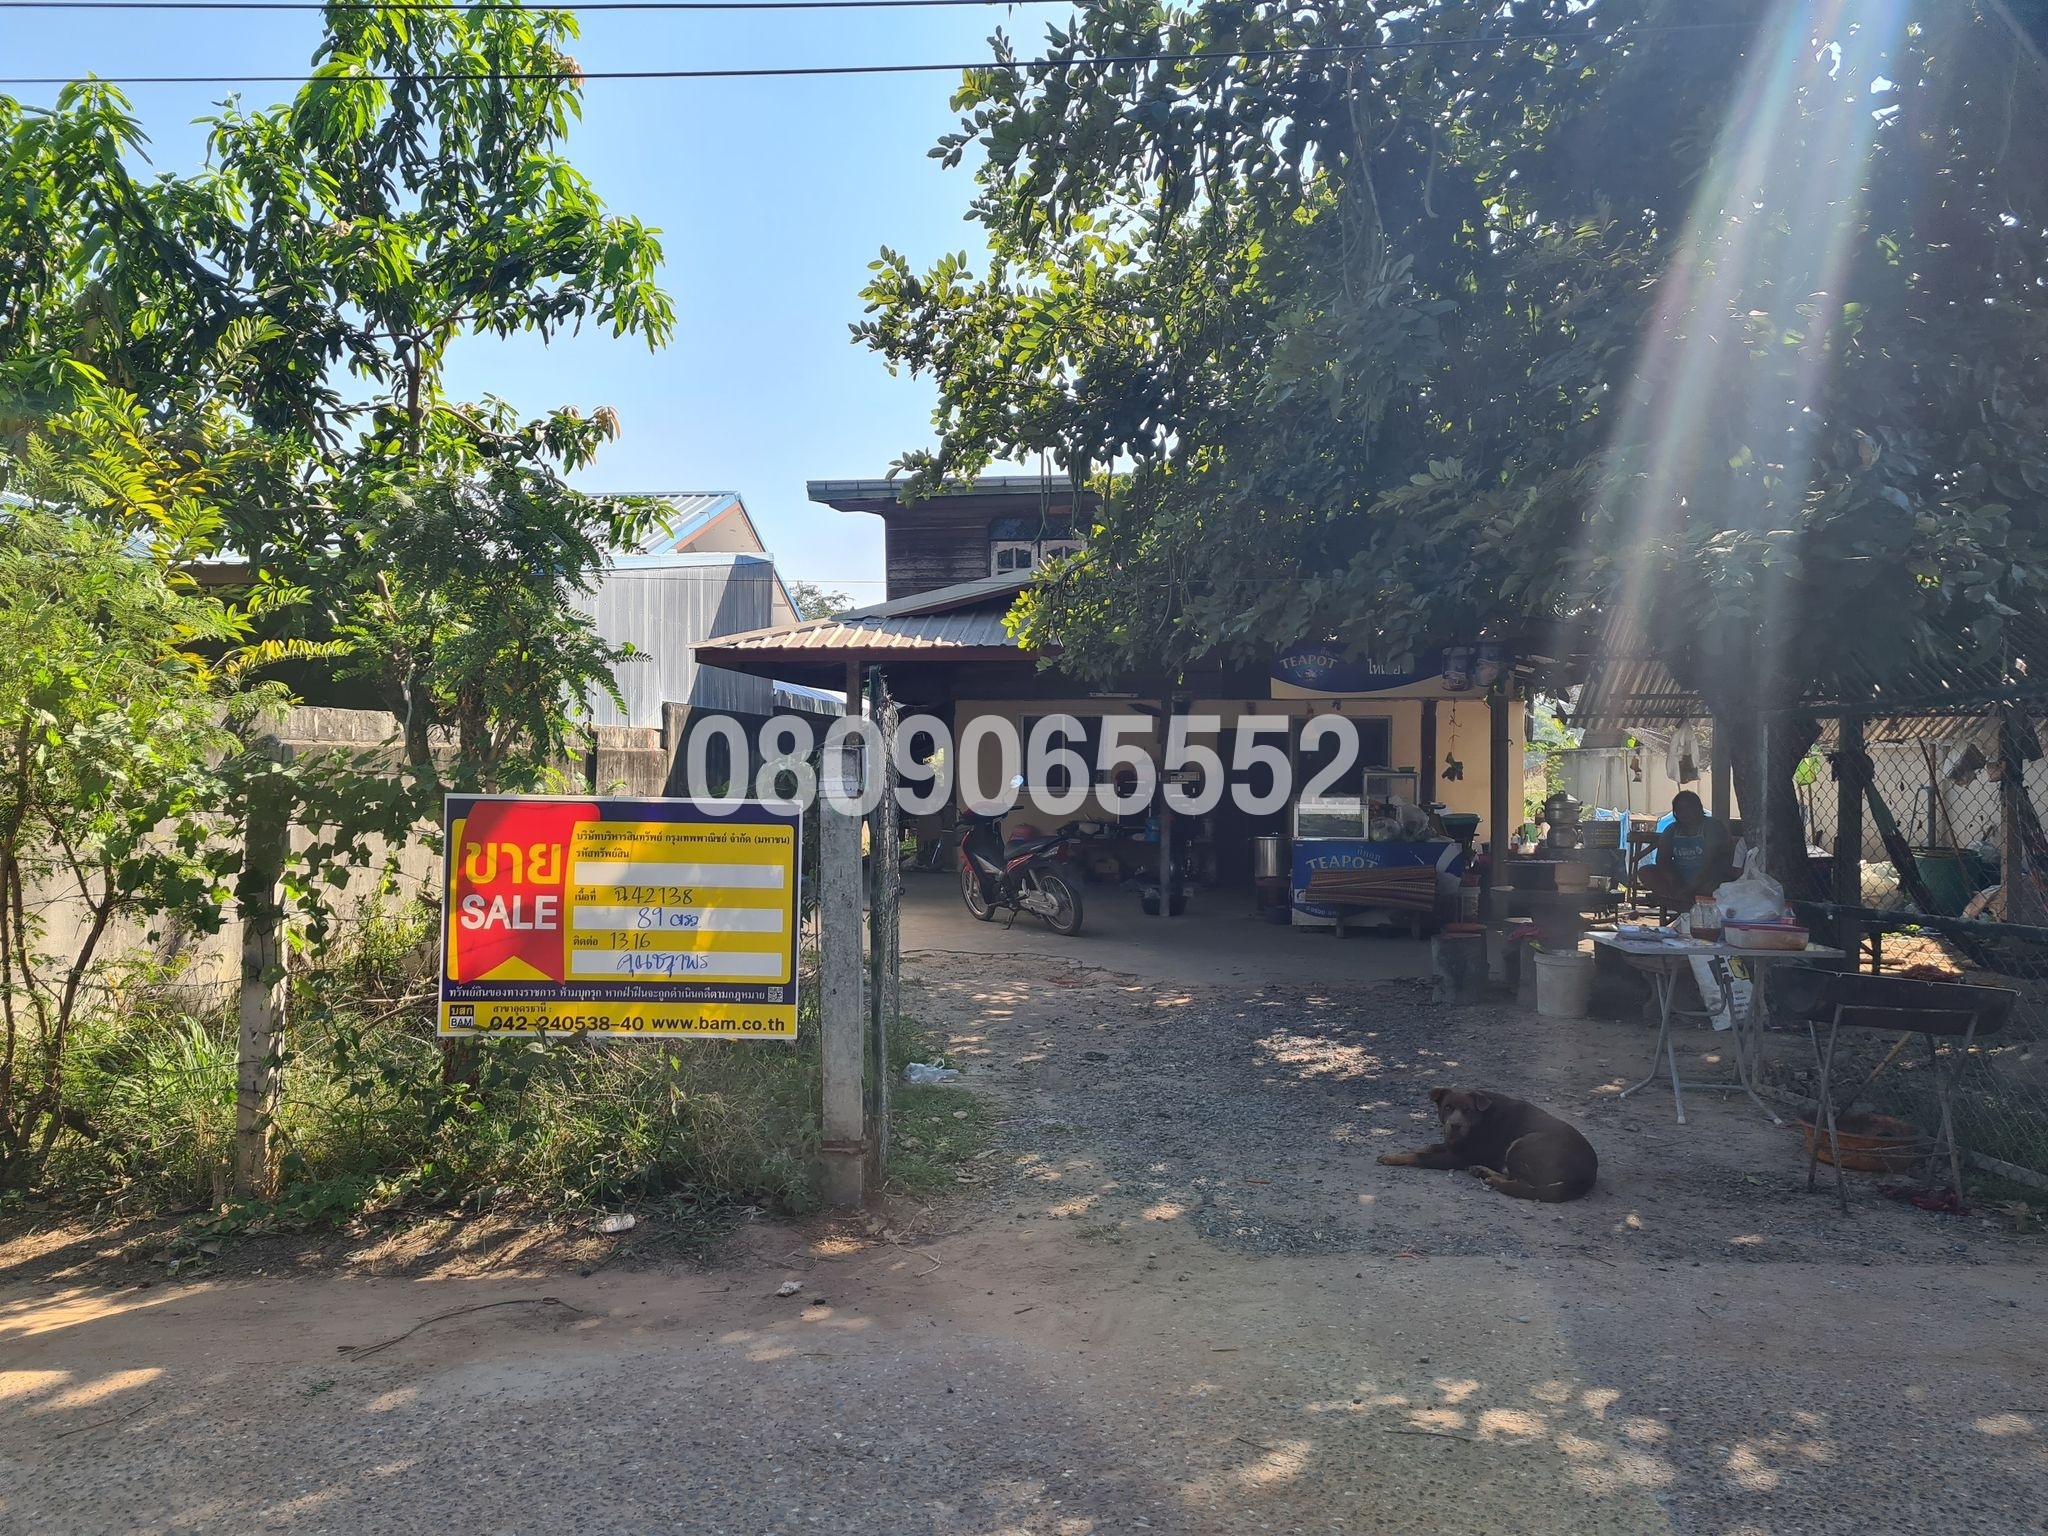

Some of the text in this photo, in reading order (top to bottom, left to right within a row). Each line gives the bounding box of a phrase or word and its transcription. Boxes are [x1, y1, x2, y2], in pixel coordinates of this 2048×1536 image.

[1279, 654, 1338, 670] TEAPOT
[665, 831, 727, 846] กรุงเทพพาณิชย์
[730, 832, 751, 844] จำกัด
[754, 835, 790, 845] (มหาชน)
[575, 847, 630, 859] รหัสทรัพย์สิน
[465, 842, 561, 885] ขาย
[1305, 855, 1379, 870] TEAPOT
[574, 889, 597, 902] เนื้อที่
[460, 893, 558, 930] SALE
[573, 935, 599, 947] ติดต่อ
[448, 986, 556, 998] ทรัพย์สินของทางราชการ
[560, 986, 602, 1001] ห้ามบุกรุก
[450, 1007, 473, 1016] บสก
[450, 1017, 474, 1028] BAM
[489, 1015, 786, 1032] 042-240538-40 www.bam.co.th
